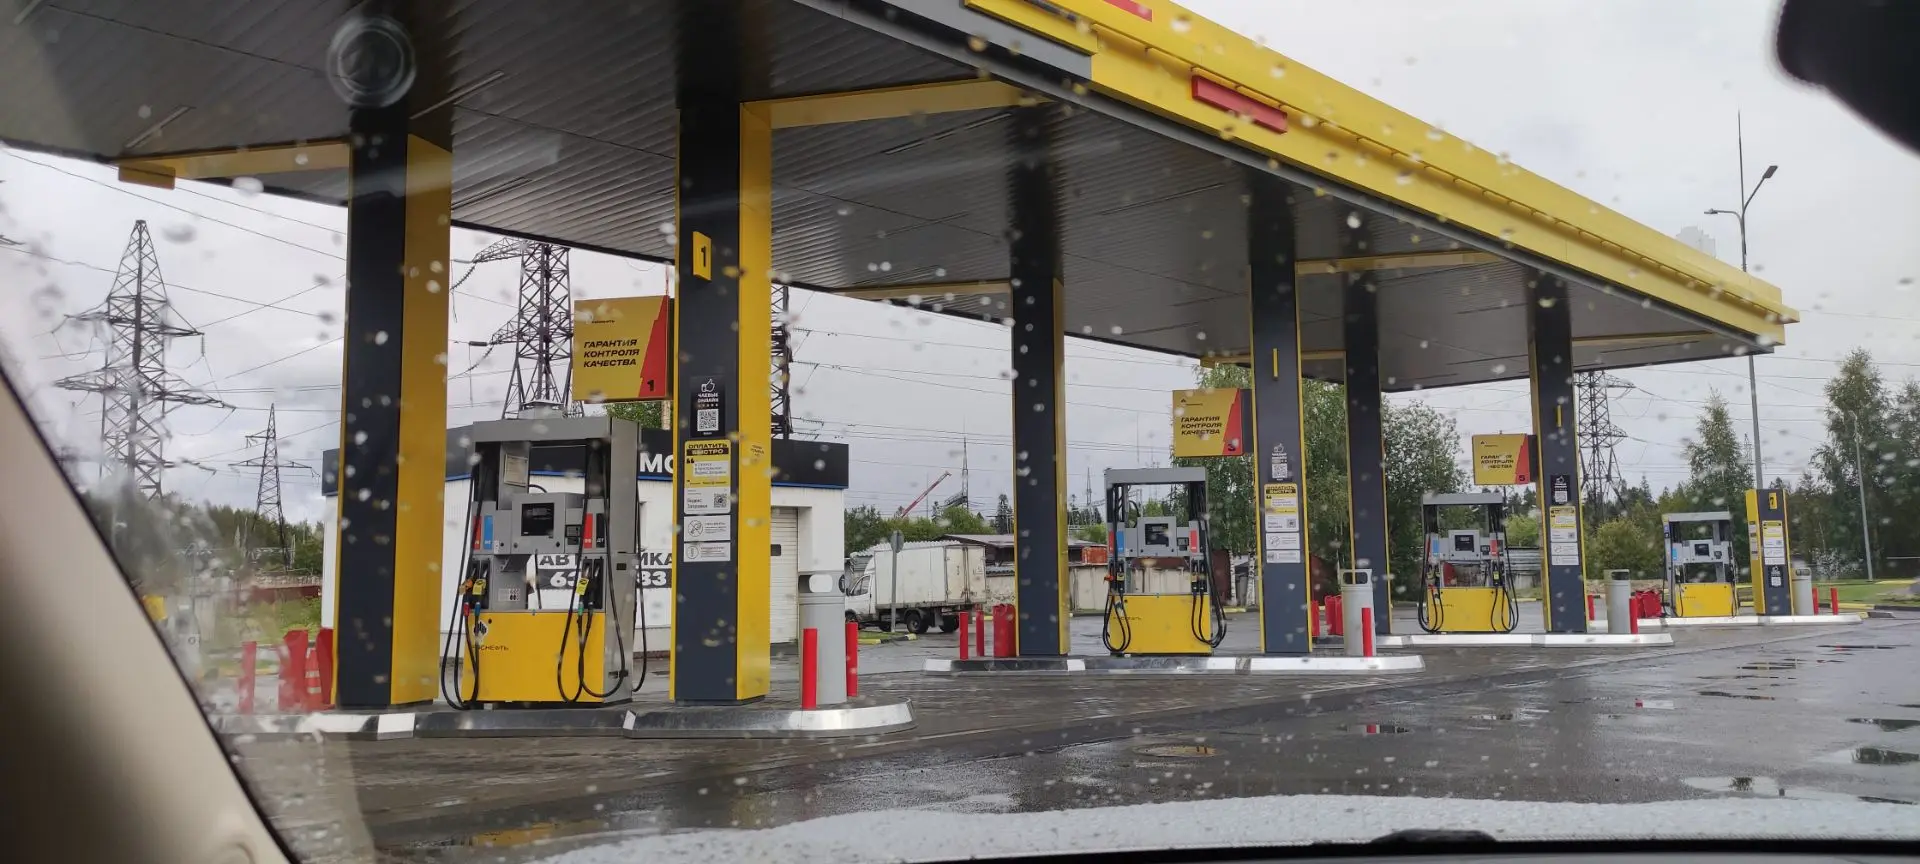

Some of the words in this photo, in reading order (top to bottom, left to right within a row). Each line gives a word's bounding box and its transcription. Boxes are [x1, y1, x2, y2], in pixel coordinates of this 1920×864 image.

[701, 246, 706, 267] 1
[584, 339, 637, 349] ГАРАНТИЯ
[584, 349, 640, 358] КОНТРОЛЯ
[584, 359, 636, 368] КАЧЕСТВА
[647, 380, 654, 391] 1
